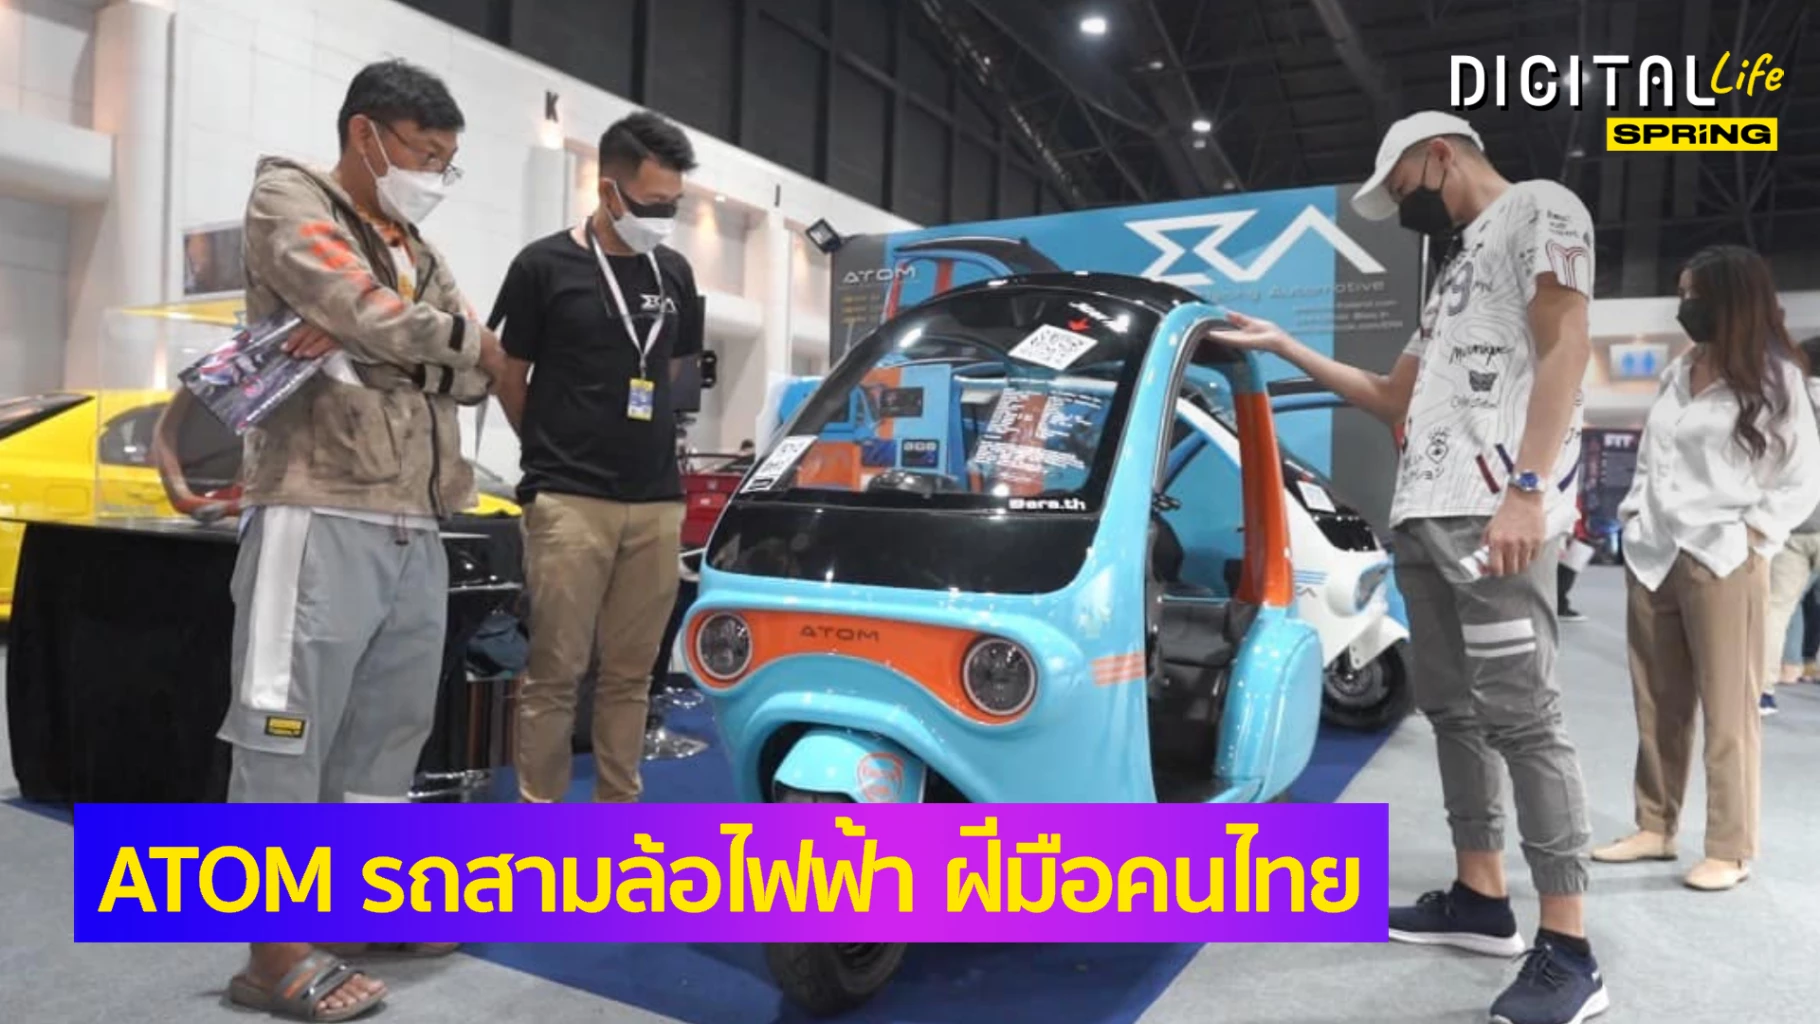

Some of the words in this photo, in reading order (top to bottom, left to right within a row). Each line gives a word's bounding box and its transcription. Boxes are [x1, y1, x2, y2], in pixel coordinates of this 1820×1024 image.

[545, 91, 559, 122] K
[843, 264, 916, 284] ATOM
[800, 624, 880, 642] ATOM
